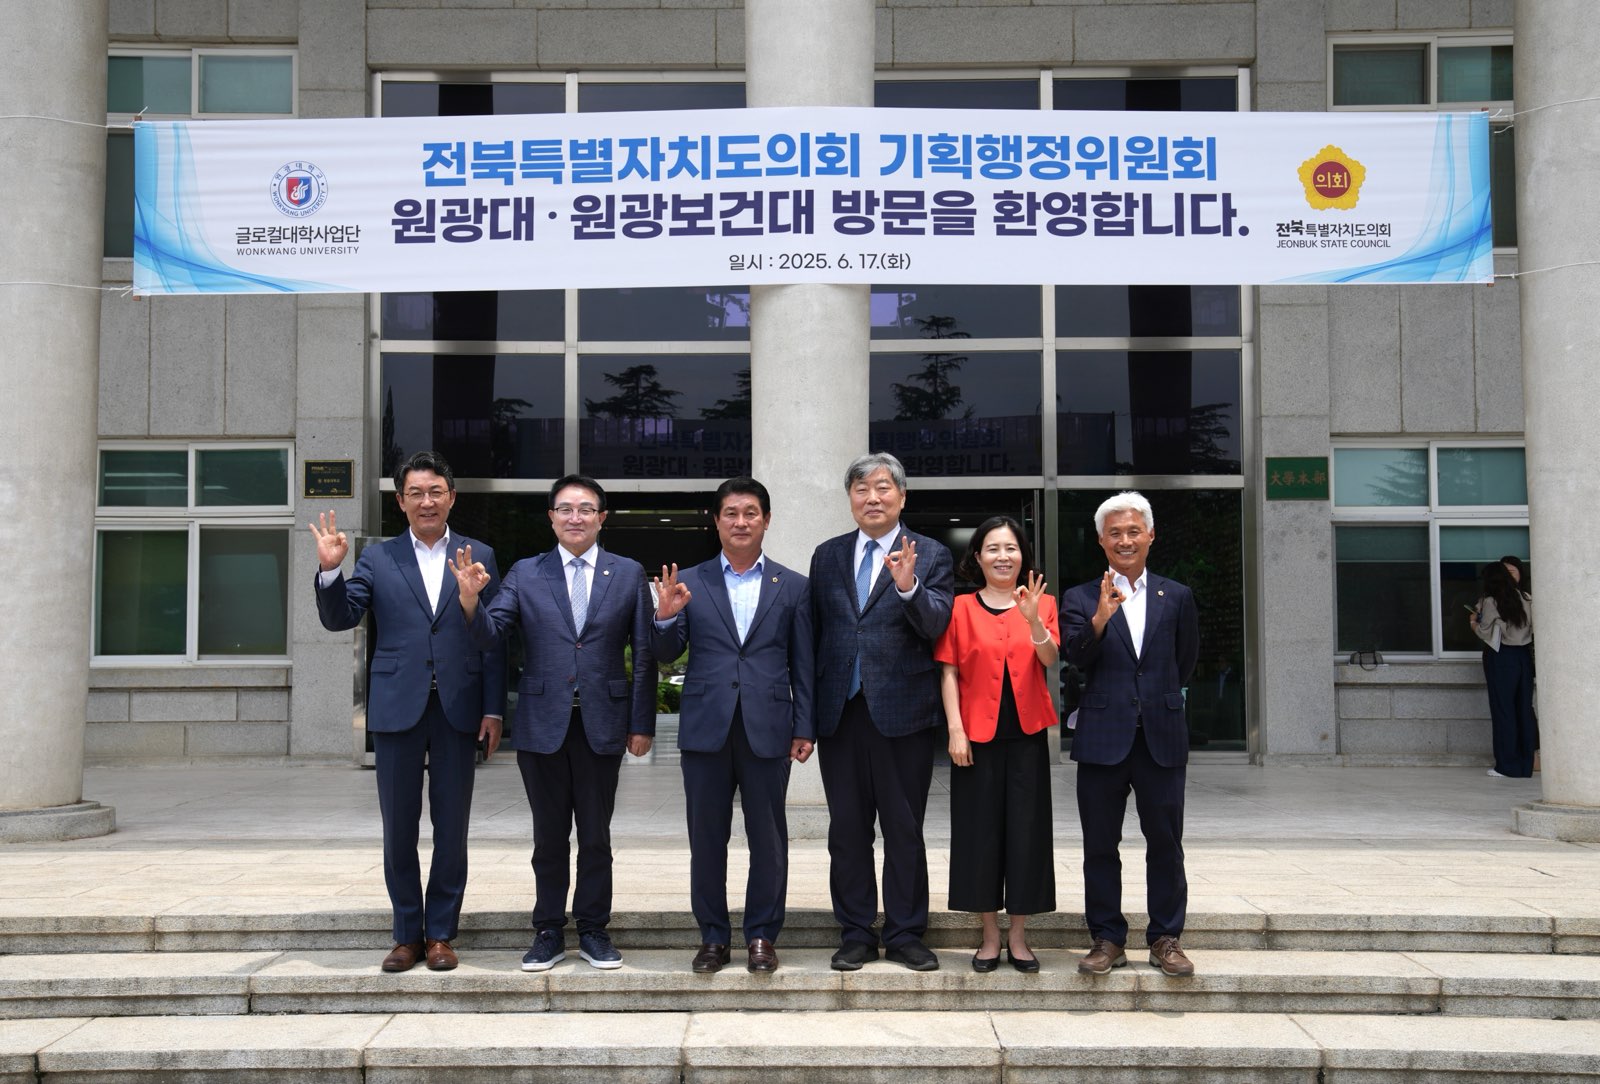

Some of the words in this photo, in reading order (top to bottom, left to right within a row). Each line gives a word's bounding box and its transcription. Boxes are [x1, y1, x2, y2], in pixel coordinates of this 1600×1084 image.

[422, 133, 861, 187] 전북특별자치도의회
[879, 132, 1217, 181] 기획행정위원회
[1315, 171, 1348, 188] 의회
[391, 196, 535, 244] 원광대
[570, 190, 815, 241] 원광보건대
[832, 189, 978, 236] 방문을
[992, 189, 1250, 237] 환영합니다.
[235, 224, 362, 245] 글로컬대학사업단
[1275, 219, 1391, 238] 전북특별자치도의회
[236, 247, 297, 256] WONKWANG
[299, 246, 360, 255] UNIVERSITY
[1276, 239, 1318, 249] JEONBUK
[1320, 239, 1348, 249] STATE
[1350, 239, 1391, 249] COUNCIL
[728, 253, 763, 271] 일시
[778, 252, 832, 270] 2025.
[837, 253, 853, 270] 6.
[858, 252, 911, 270] 17.(화)
